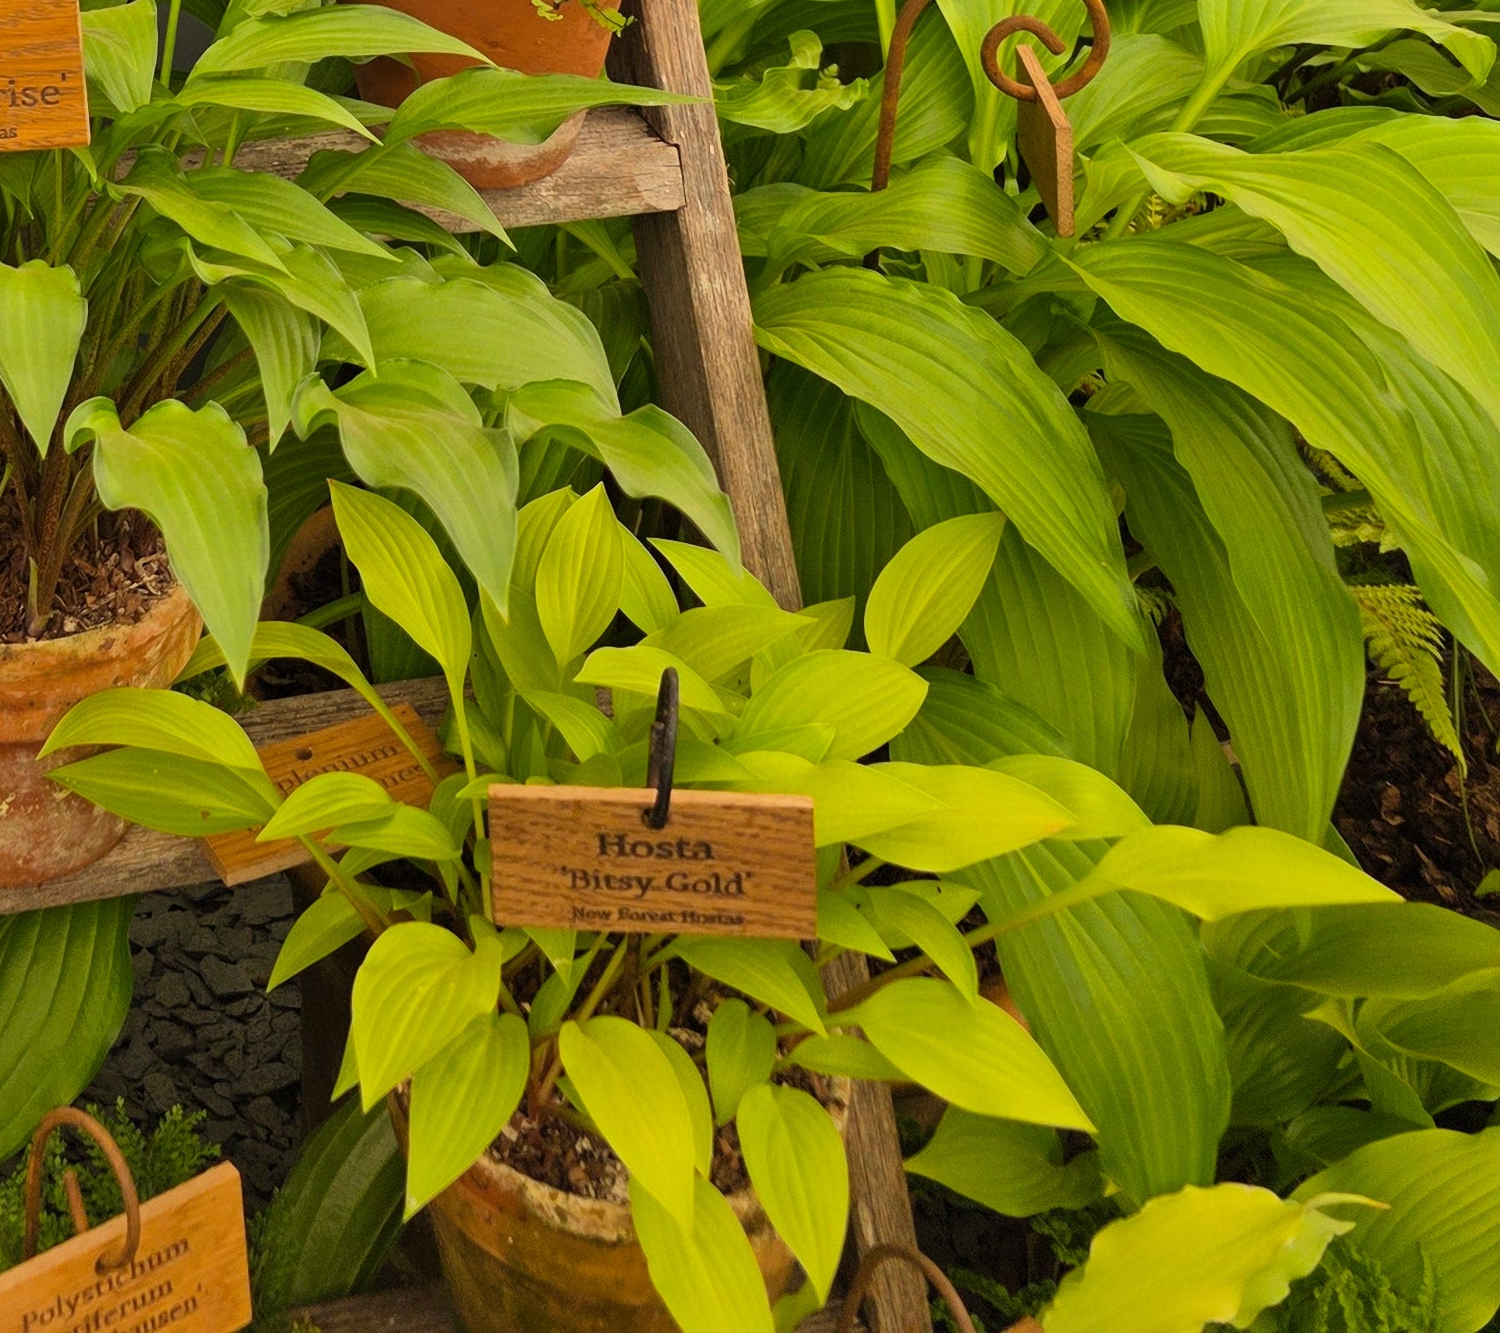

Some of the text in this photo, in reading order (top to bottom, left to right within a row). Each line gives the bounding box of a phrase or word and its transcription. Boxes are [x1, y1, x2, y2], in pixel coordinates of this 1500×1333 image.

[595, 832, 717, 862] Hosta
[560, 865, 753, 899] 'Bitsy Gold'
[570, 906, 746, 926] New Forest Hostas
